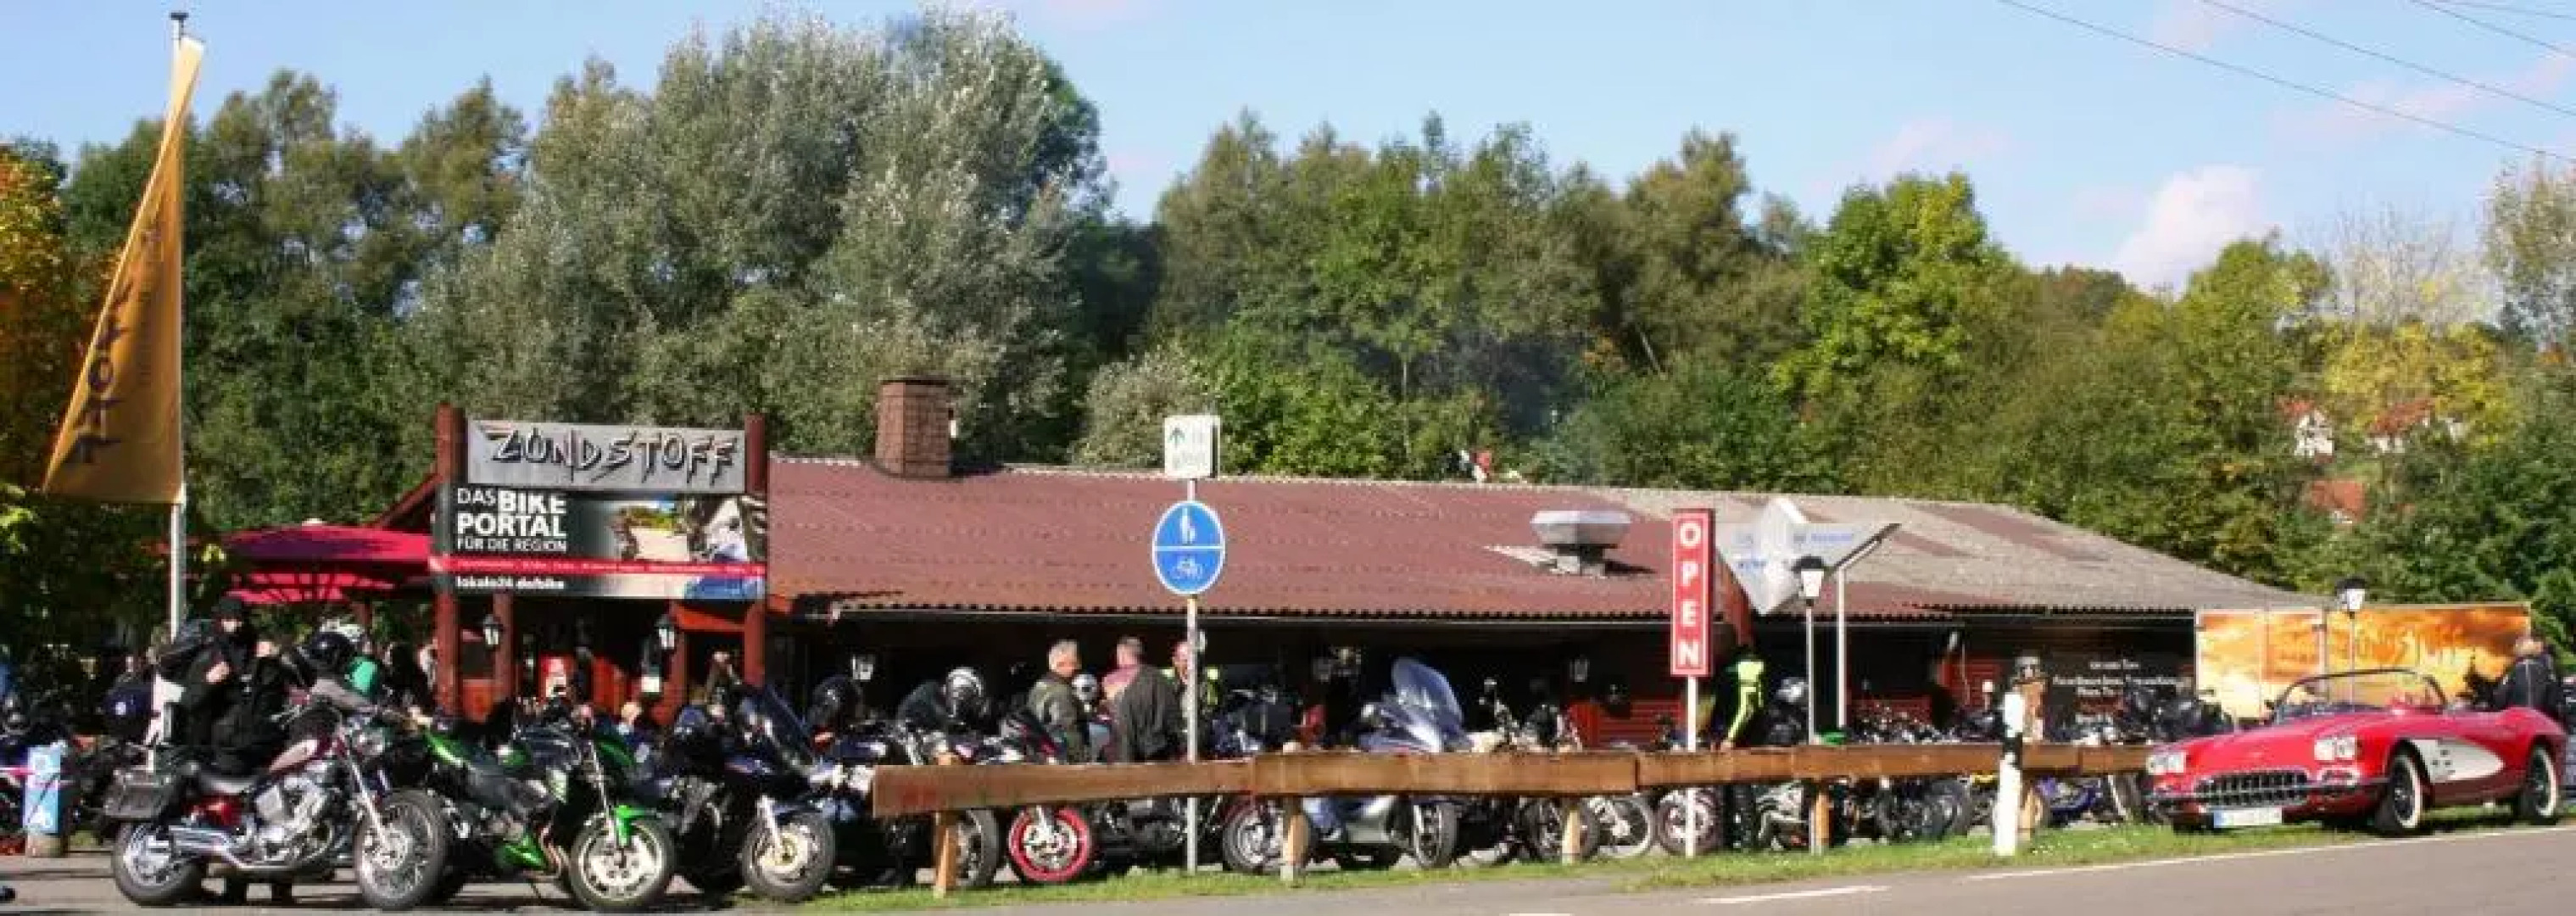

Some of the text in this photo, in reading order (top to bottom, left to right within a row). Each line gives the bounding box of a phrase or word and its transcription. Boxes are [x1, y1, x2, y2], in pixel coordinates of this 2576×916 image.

[457, 488, 566, 514] DAS BIKE
[457, 512, 567, 537] PORTAL
[457, 536, 567, 551] FÜR DIE REGION
[1678, 522, 1702, 665] OPEN
